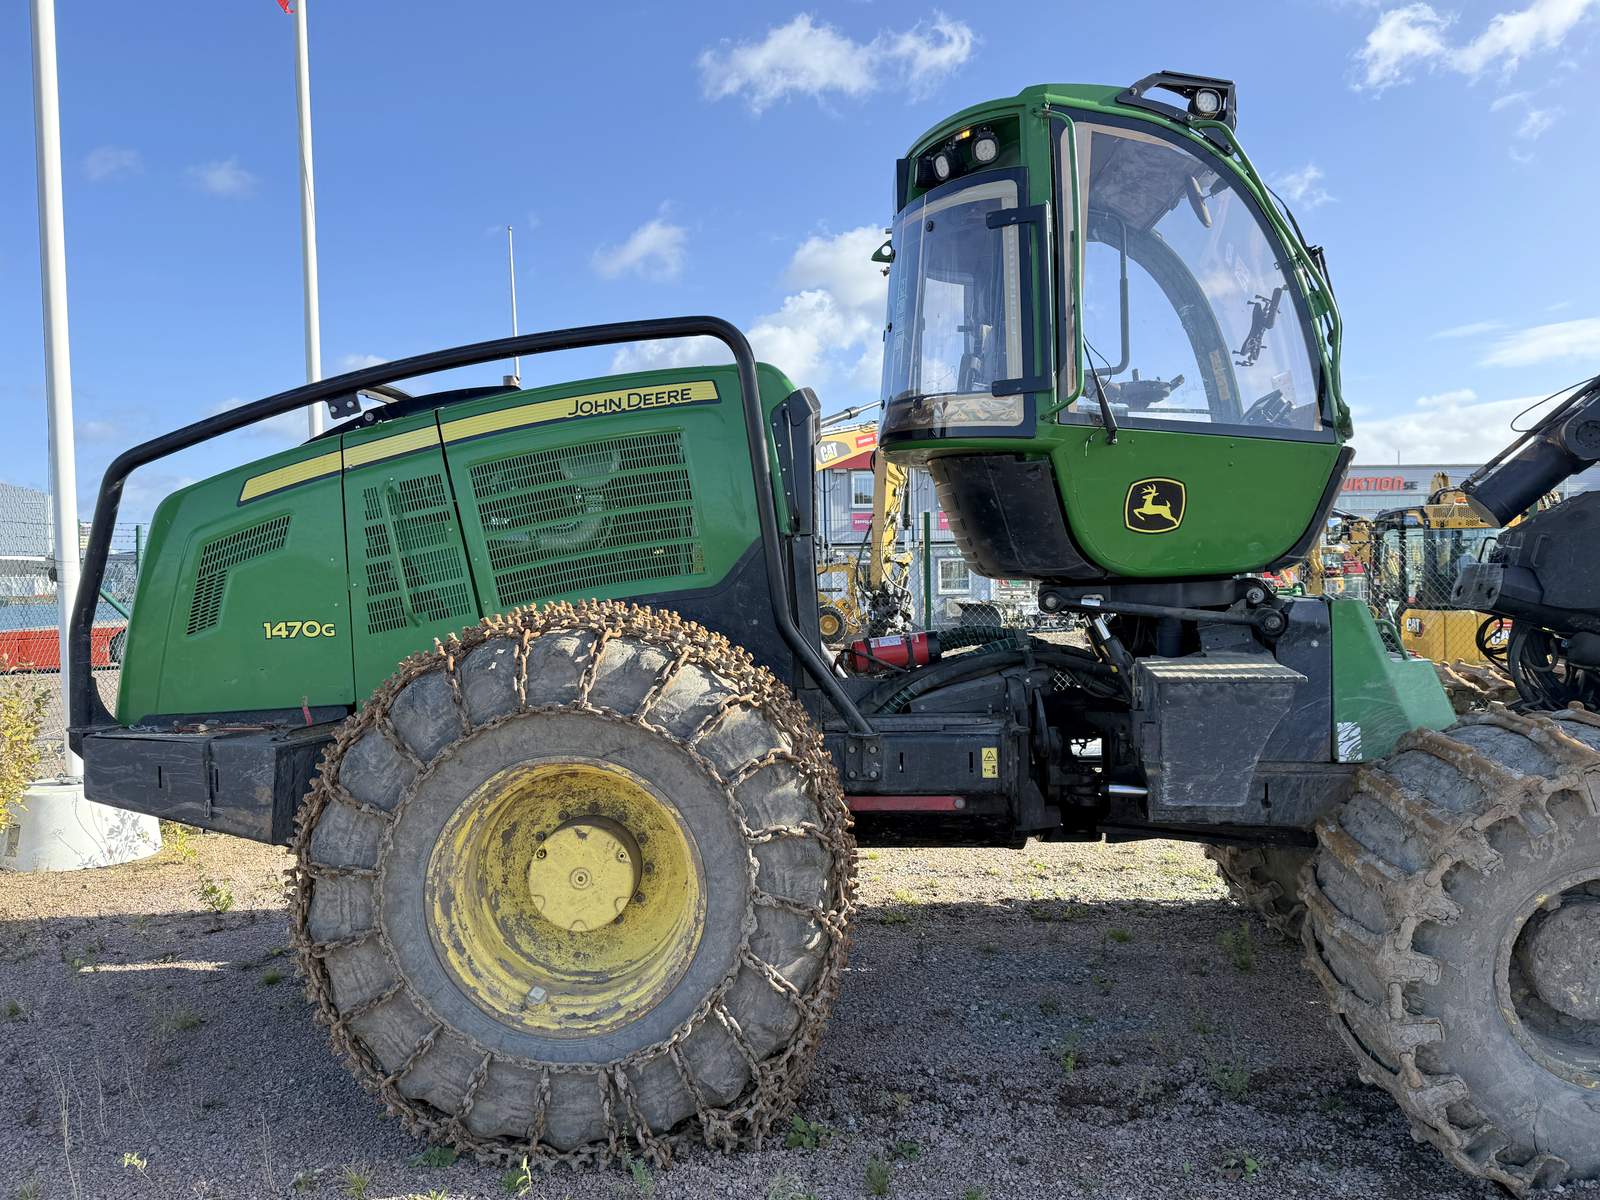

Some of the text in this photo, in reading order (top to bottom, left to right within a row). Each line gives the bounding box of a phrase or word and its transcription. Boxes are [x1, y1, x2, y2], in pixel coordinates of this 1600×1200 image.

[568, 388, 692, 415] JOHN DEERE
[820, 442, 837, 461] CAT
[262, 619, 336, 640] 1470G
[1406, 618, 1420, 634] CAT
[1490, 629, 1511, 645] CA
